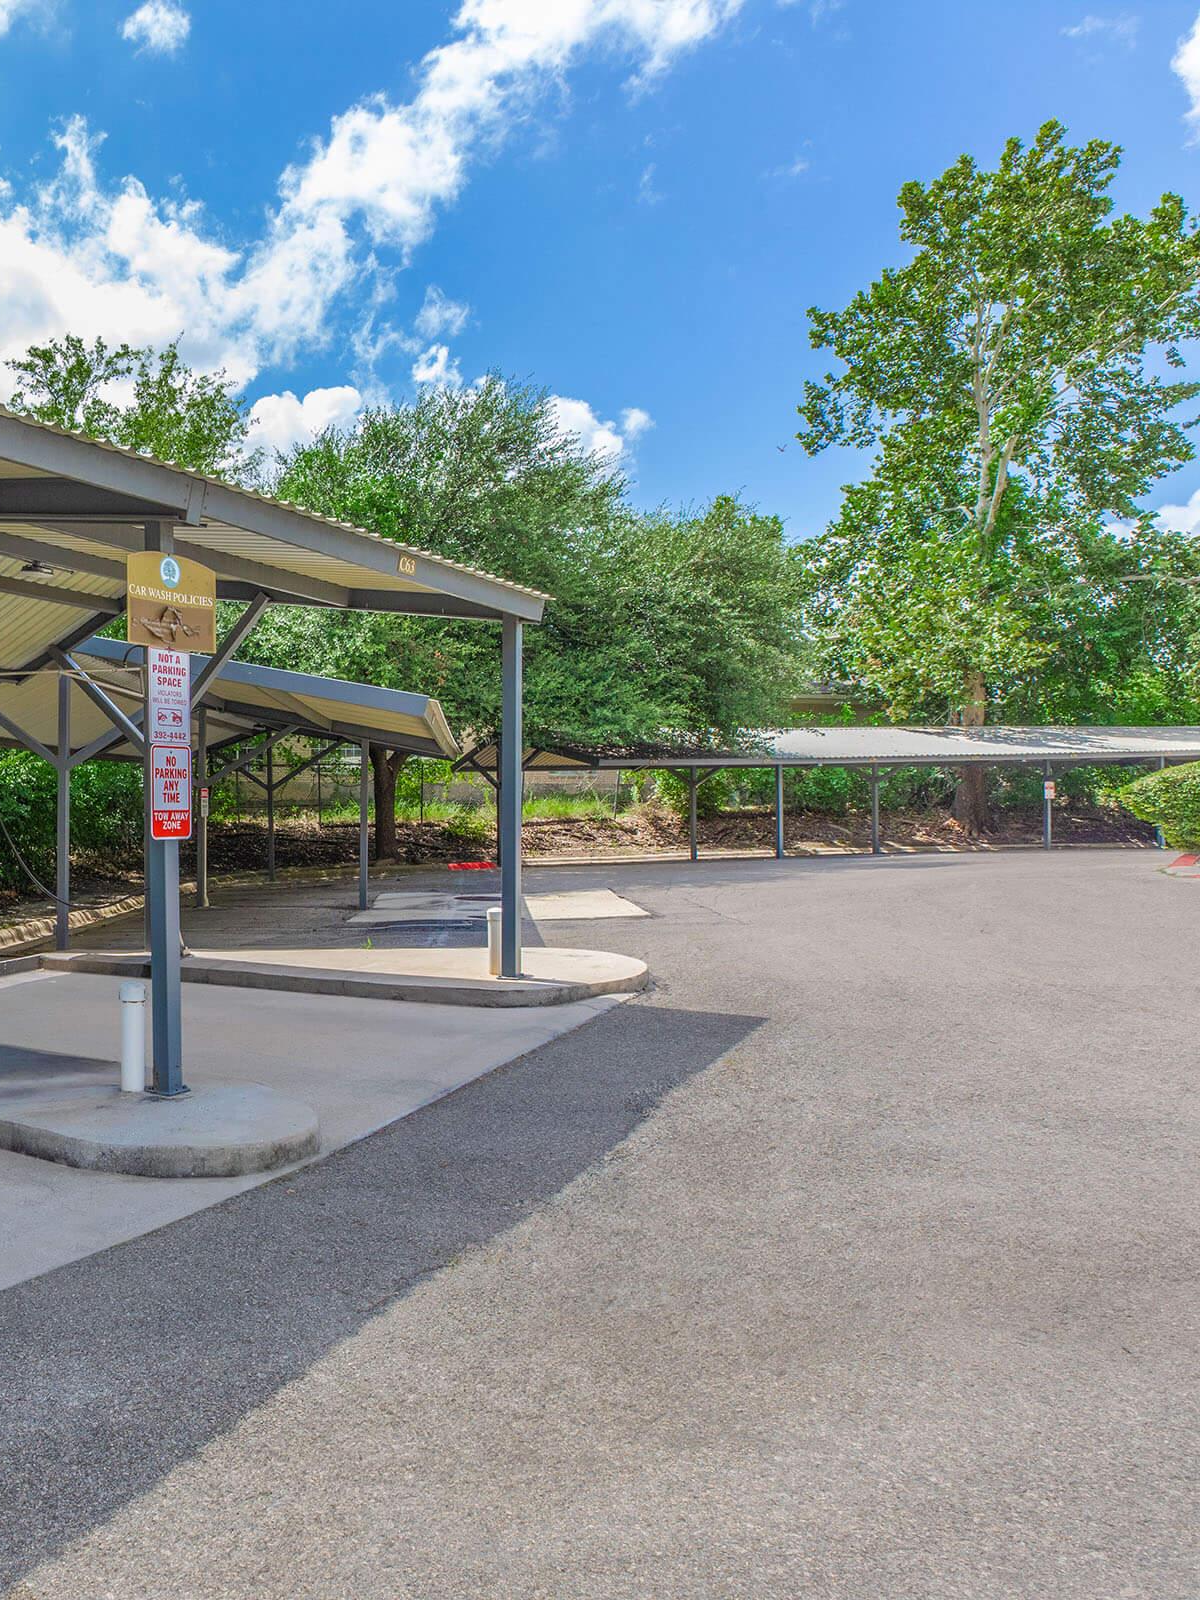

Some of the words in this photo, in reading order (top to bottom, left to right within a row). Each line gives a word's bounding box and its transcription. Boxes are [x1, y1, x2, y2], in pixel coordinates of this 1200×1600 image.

[129, 583, 147, 595] CAR
[148, 587, 172, 601] WASH
[172, 592, 213, 607] POLICIES
[158, 653, 173, 664] NOT
[175, 656, 180, 665] A
[152, 664, 186, 677] PARKING
[157, 676, 182, 688] SPACE
[158, 690, 182, 698] VIOLATORS
[166, 755, 176, 767] NO
[155, 768, 187, 779] PARKING
[163, 780, 179, 792] ANY
[162, 792, 180, 803] TIME
[154, 812, 169, 821] TOW
[170, 812, 189, 821] AWAY
[162, 820, 181, 830] ZONE
